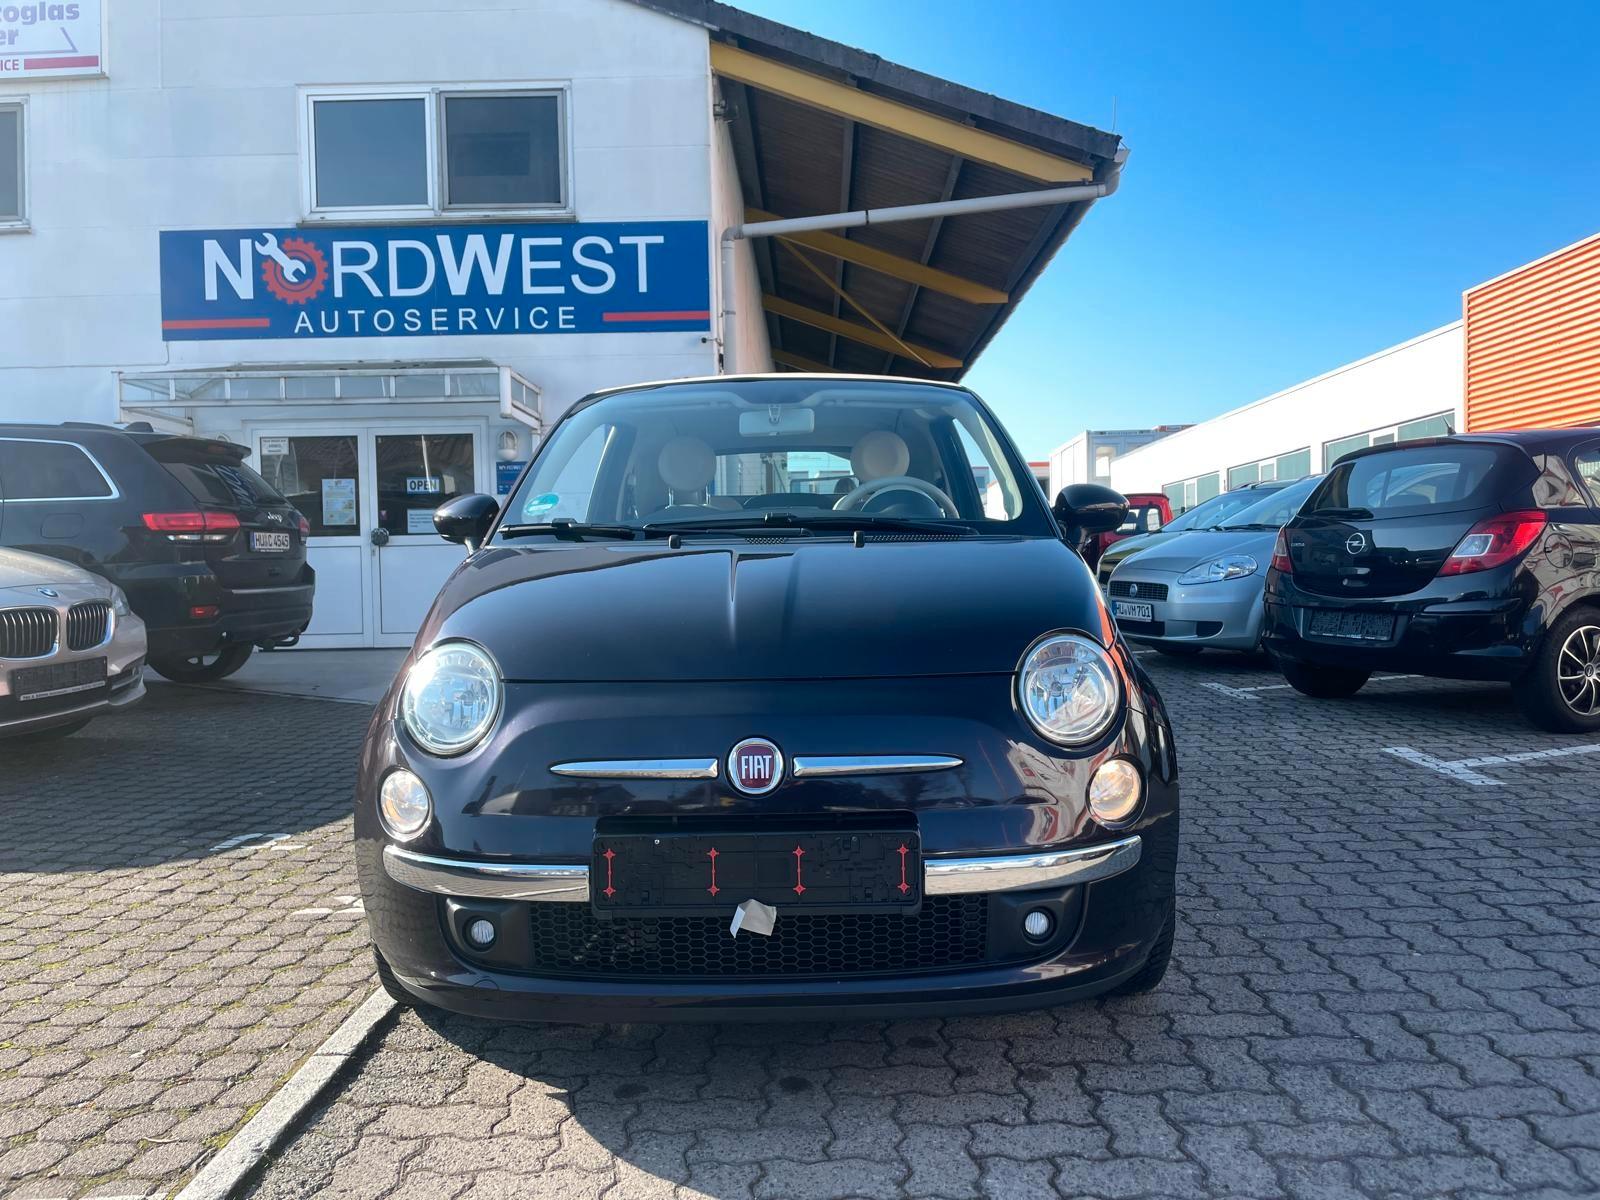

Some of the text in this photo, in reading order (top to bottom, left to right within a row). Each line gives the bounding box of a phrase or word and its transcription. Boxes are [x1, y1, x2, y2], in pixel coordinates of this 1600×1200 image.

[0, 1, 80, 25] oglas
[203, 233, 665, 304] NORDWEST
[294, 306, 576, 333] AUTOSERVICE
[410, 480, 437, 491] OPEN
[267, 511, 282, 523] Jeep
[741, 755, 772, 780] FIAT
